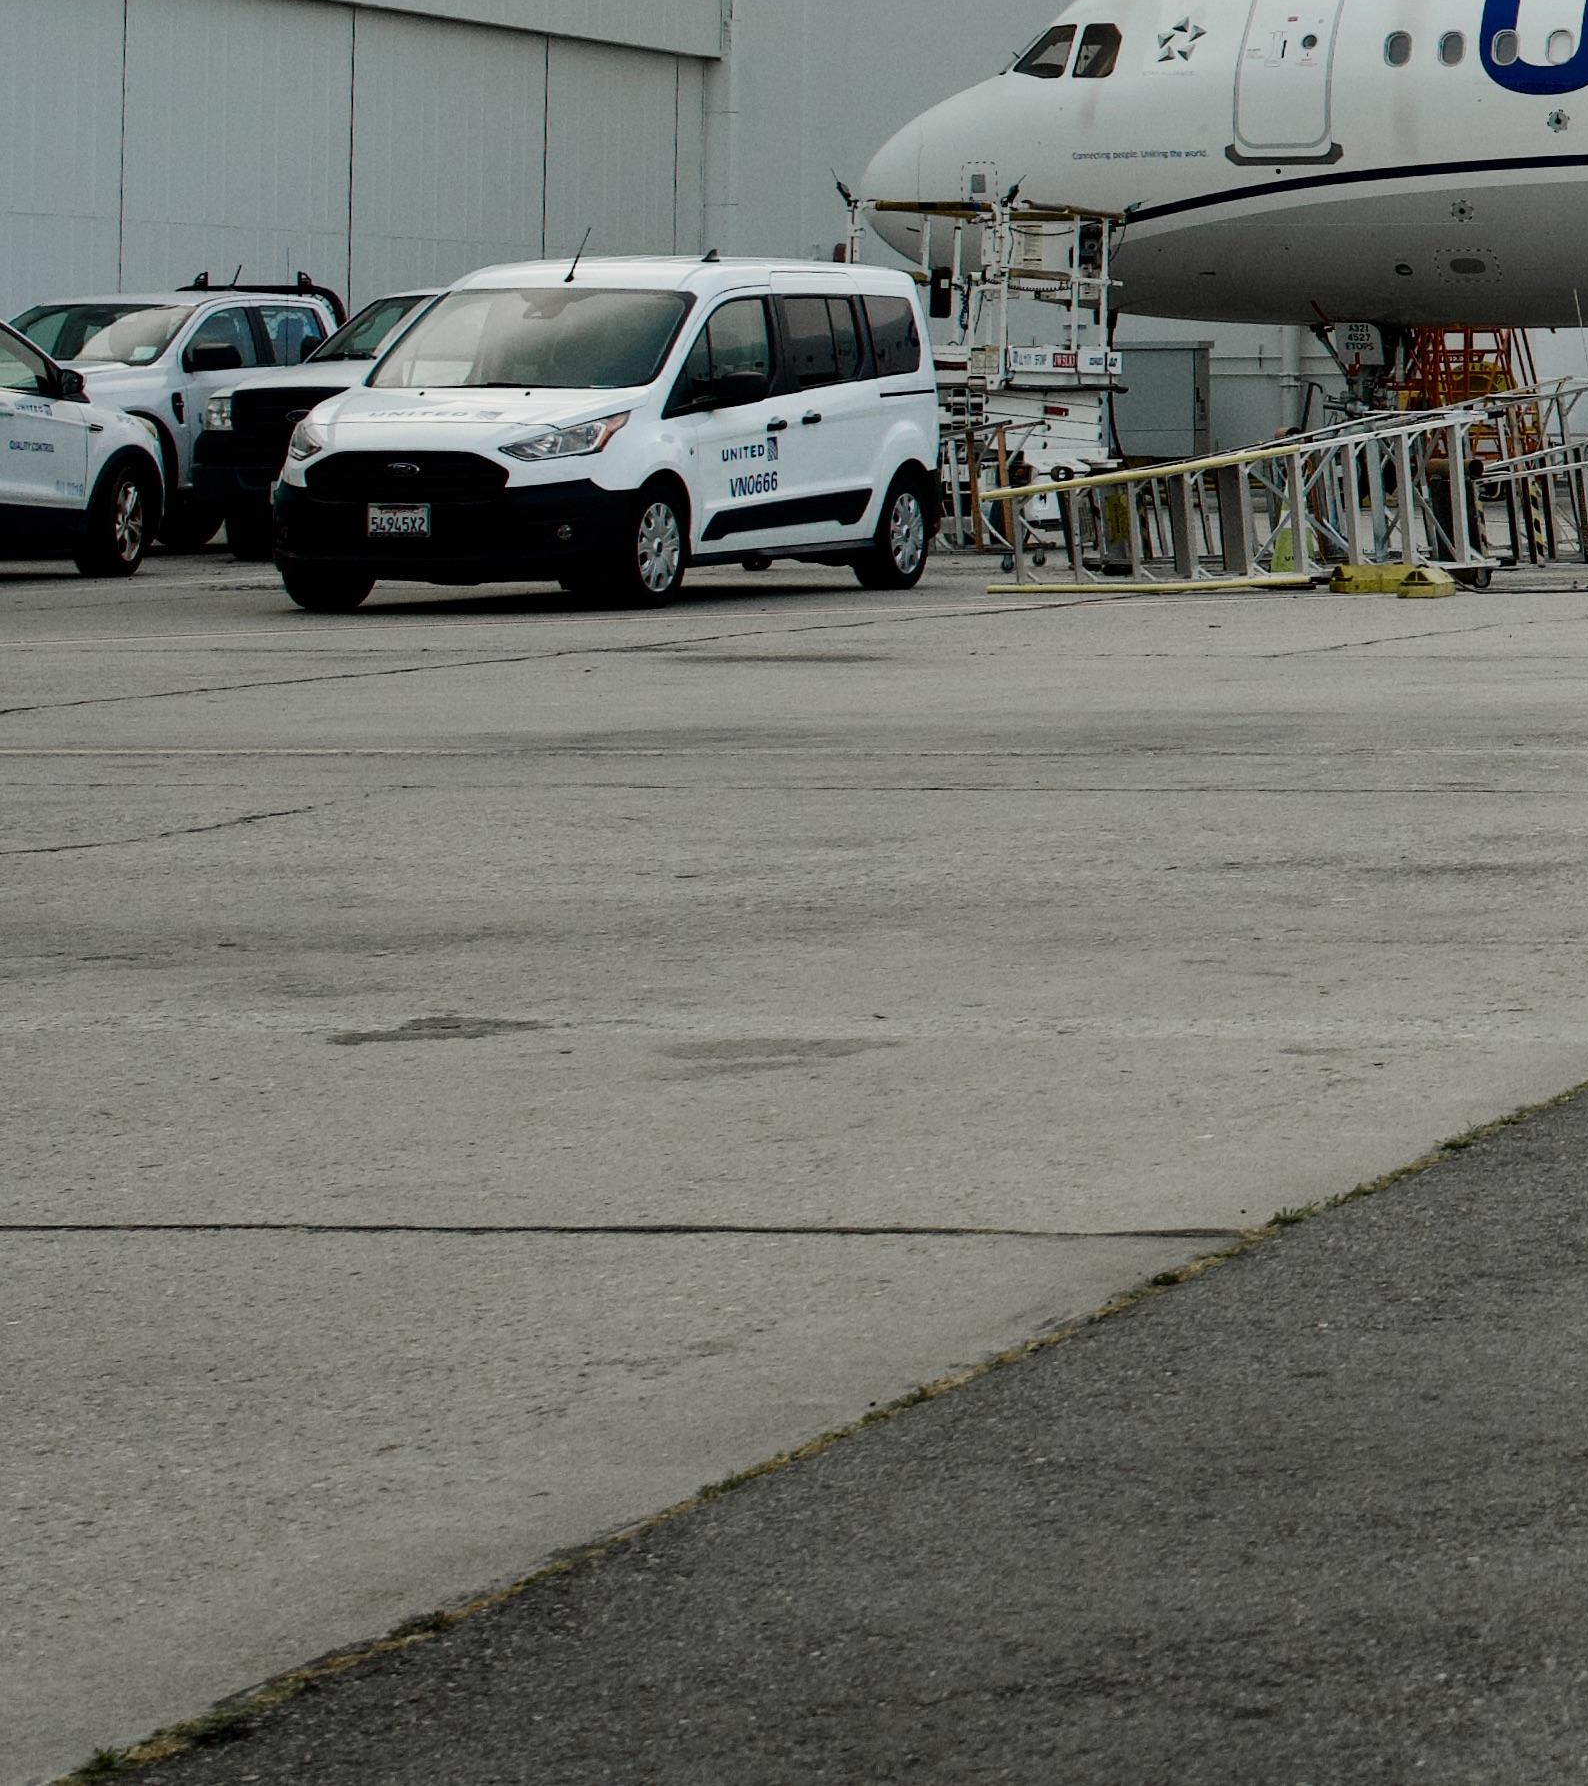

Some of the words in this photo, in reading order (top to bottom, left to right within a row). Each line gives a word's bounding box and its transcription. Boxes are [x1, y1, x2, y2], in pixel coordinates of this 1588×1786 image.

[1348, 324, 1369, 332] A321
[1347, 333, 1371, 342] 4527
[1345, 342, 1375, 351] ETOPS
[721, 444, 765, 462] UNITED
[729, 471, 778, 498] VN0666
[371, 517, 425, 533] 54945X2
